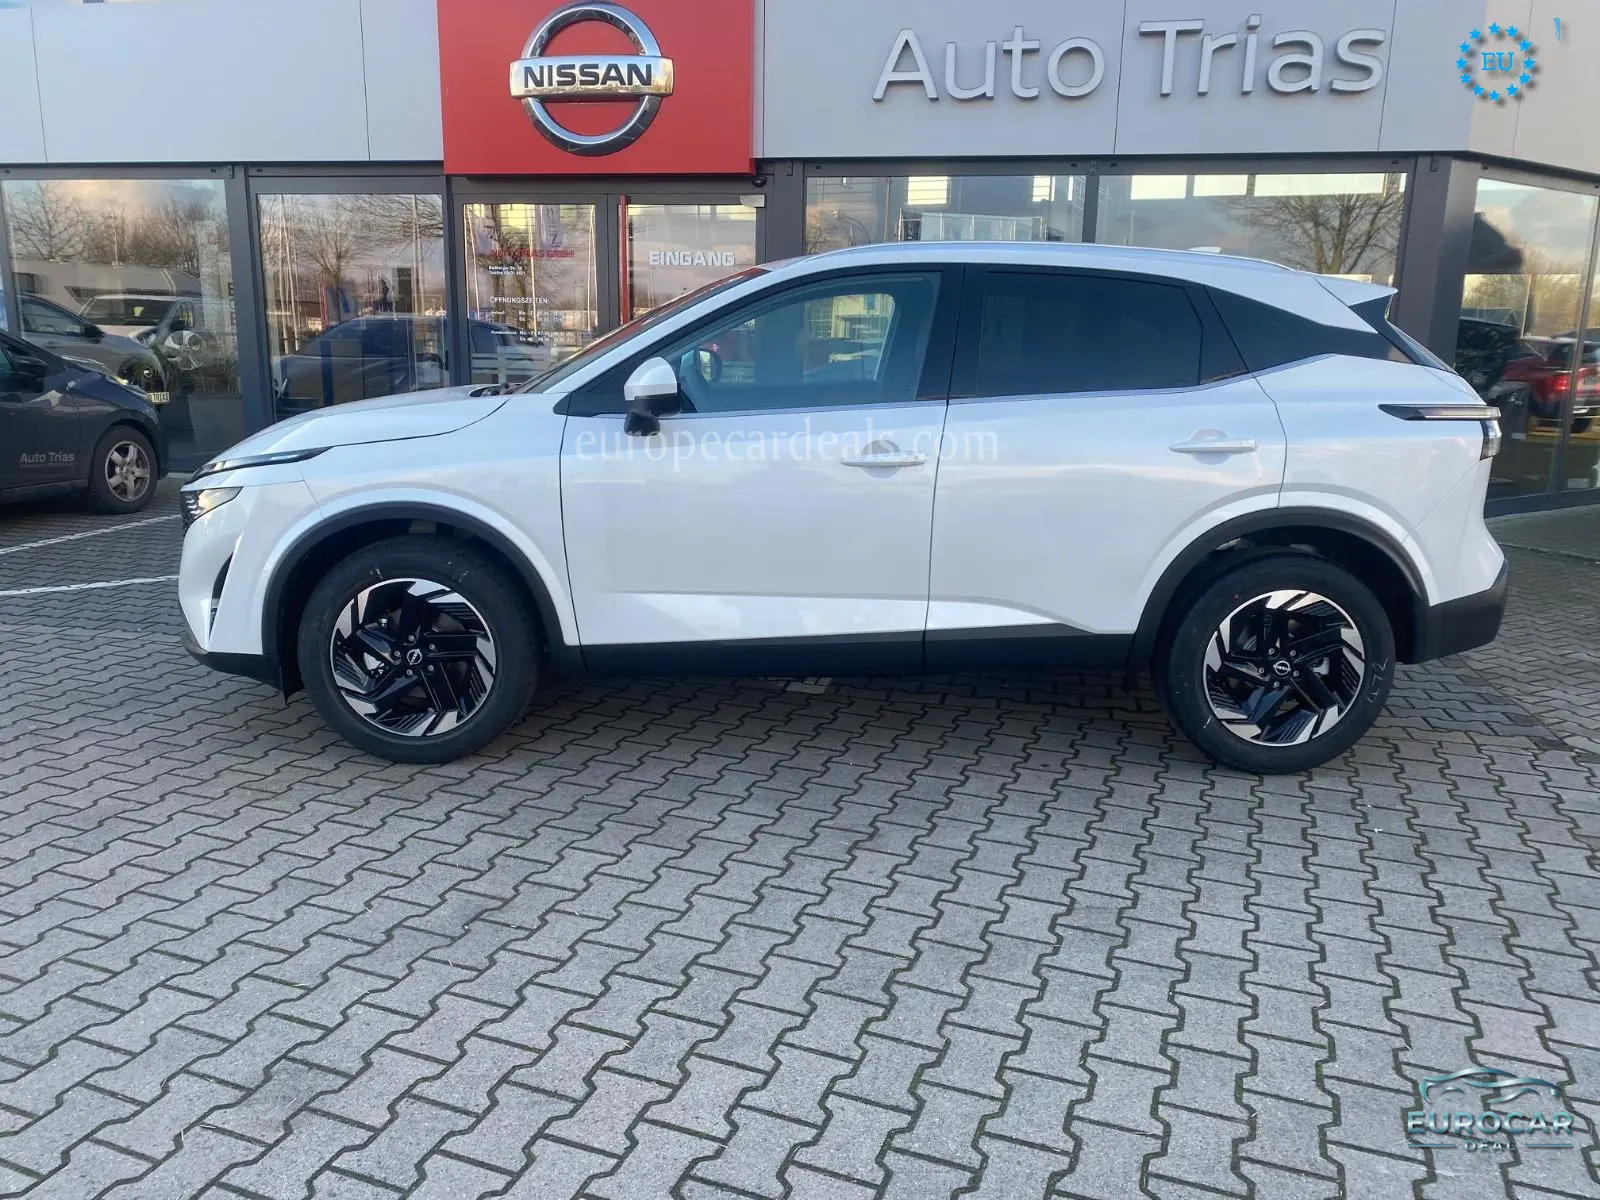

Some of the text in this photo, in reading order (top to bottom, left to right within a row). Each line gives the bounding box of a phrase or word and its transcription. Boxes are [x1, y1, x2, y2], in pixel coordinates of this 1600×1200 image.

[872, 13, 1387, 101] Auto Trias
[523, 63, 653, 88] NISSAN
[649, 251, 735, 266] EINGANG
[489, 296, 550, 304] ÖFFNUNGSZEITEN:
[20, 451, 75, 463] Auto Trias
